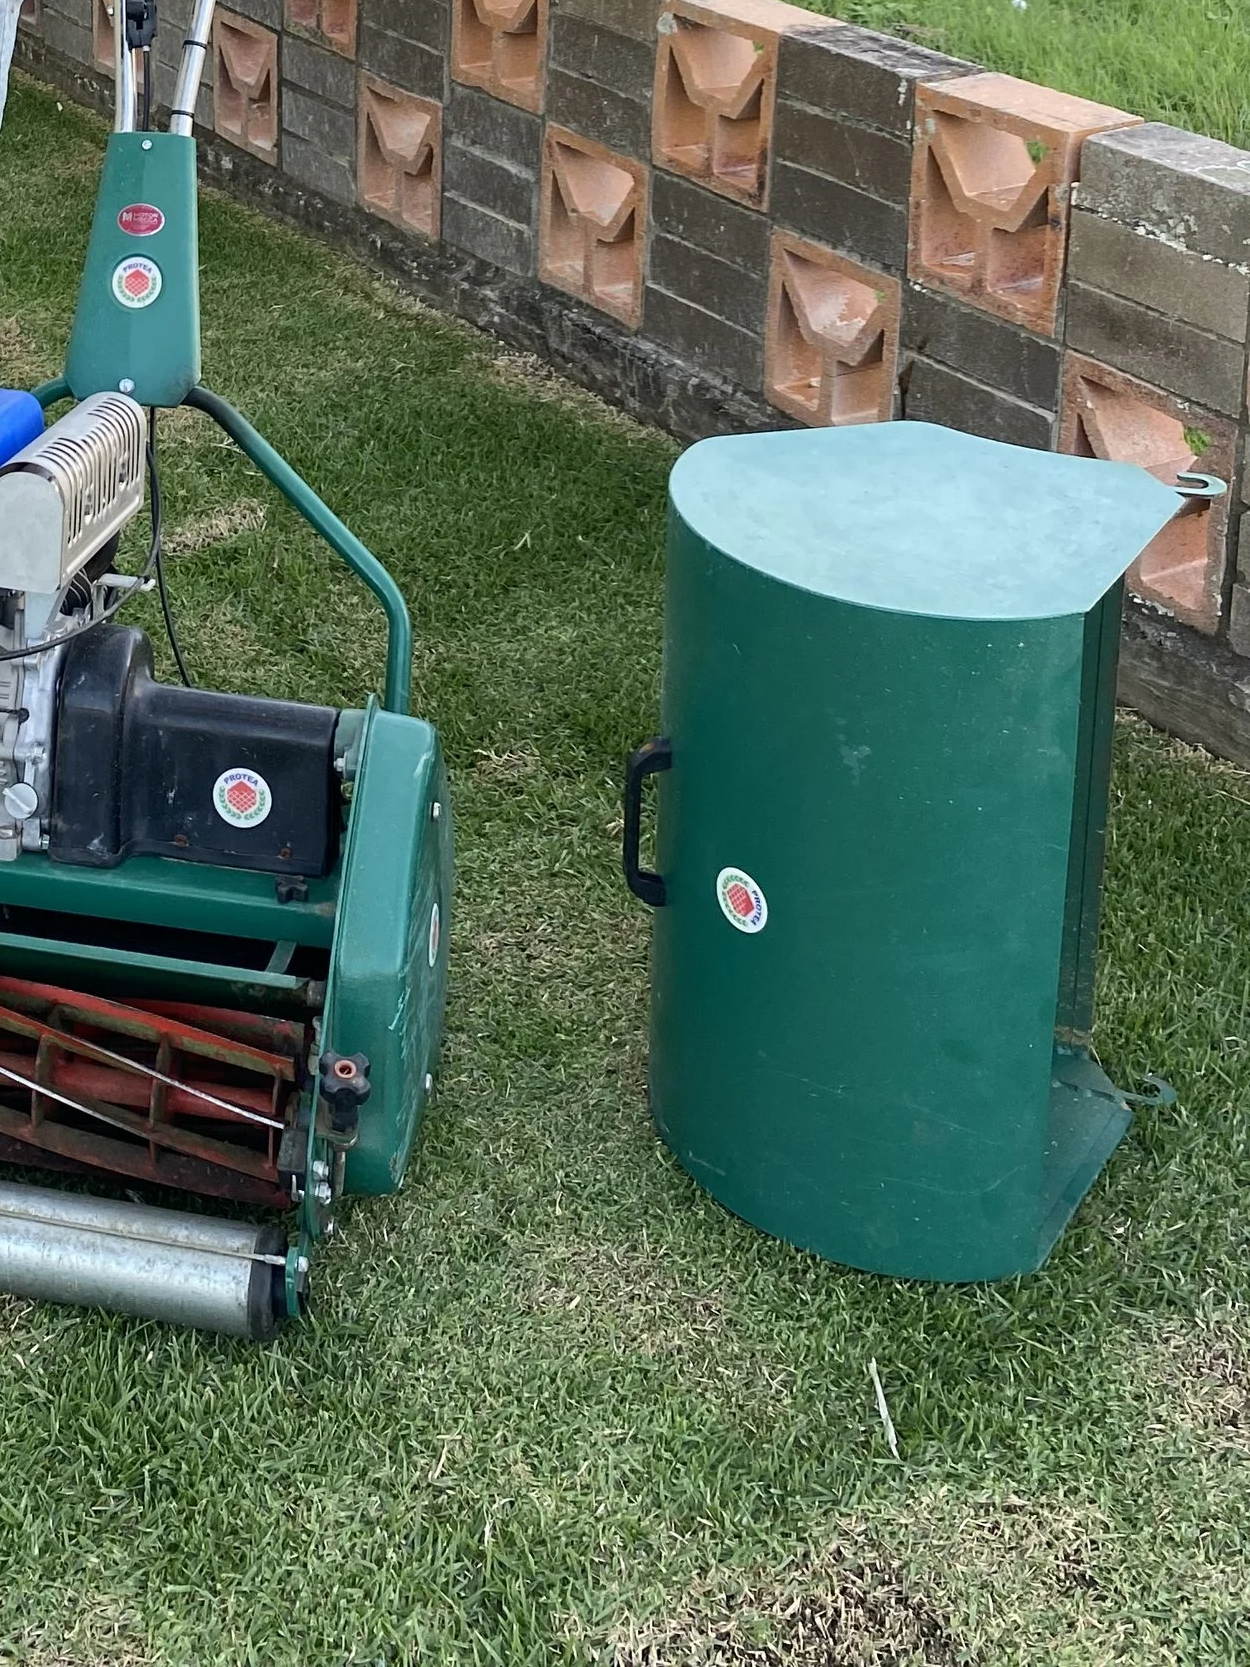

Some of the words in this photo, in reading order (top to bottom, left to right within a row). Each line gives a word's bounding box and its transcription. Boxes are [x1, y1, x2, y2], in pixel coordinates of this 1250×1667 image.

[123, 263, 152, 273] PROTEA
[223, 773, 259, 786] PROTEA
[751, 890, 762, 926] PROTEA
